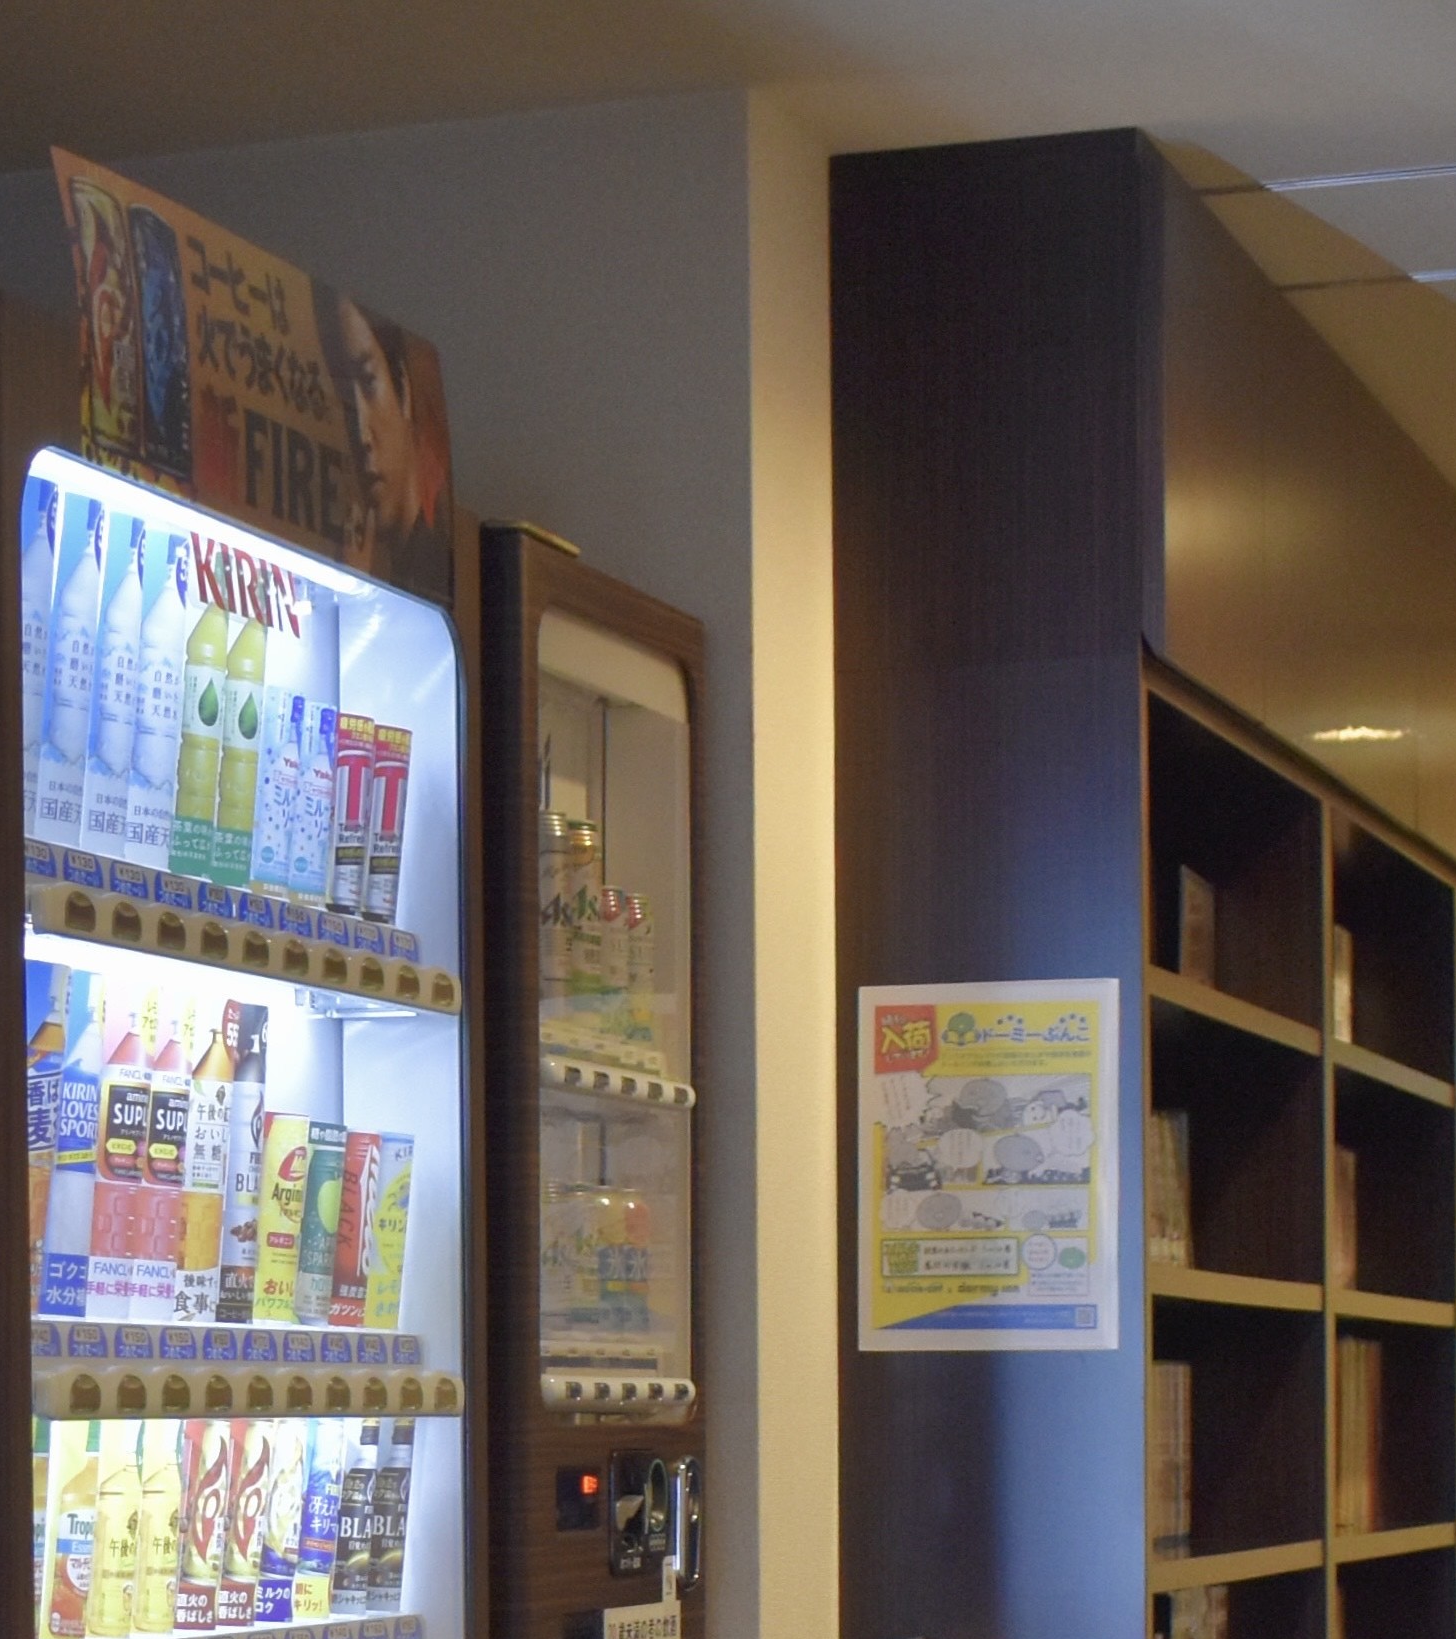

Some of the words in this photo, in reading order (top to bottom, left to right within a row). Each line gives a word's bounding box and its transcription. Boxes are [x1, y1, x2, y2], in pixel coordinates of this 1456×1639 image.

[243, 407, 353, 535] FIRE
[189, 530, 302, 639] KIRIN
[62, 1081, 98, 1101] KIRIN
[176, 1592, 208, 1608] 直火の
[217, 1590, 248, 1605] 直火の
[255, 1601, 275, 1614] コク
